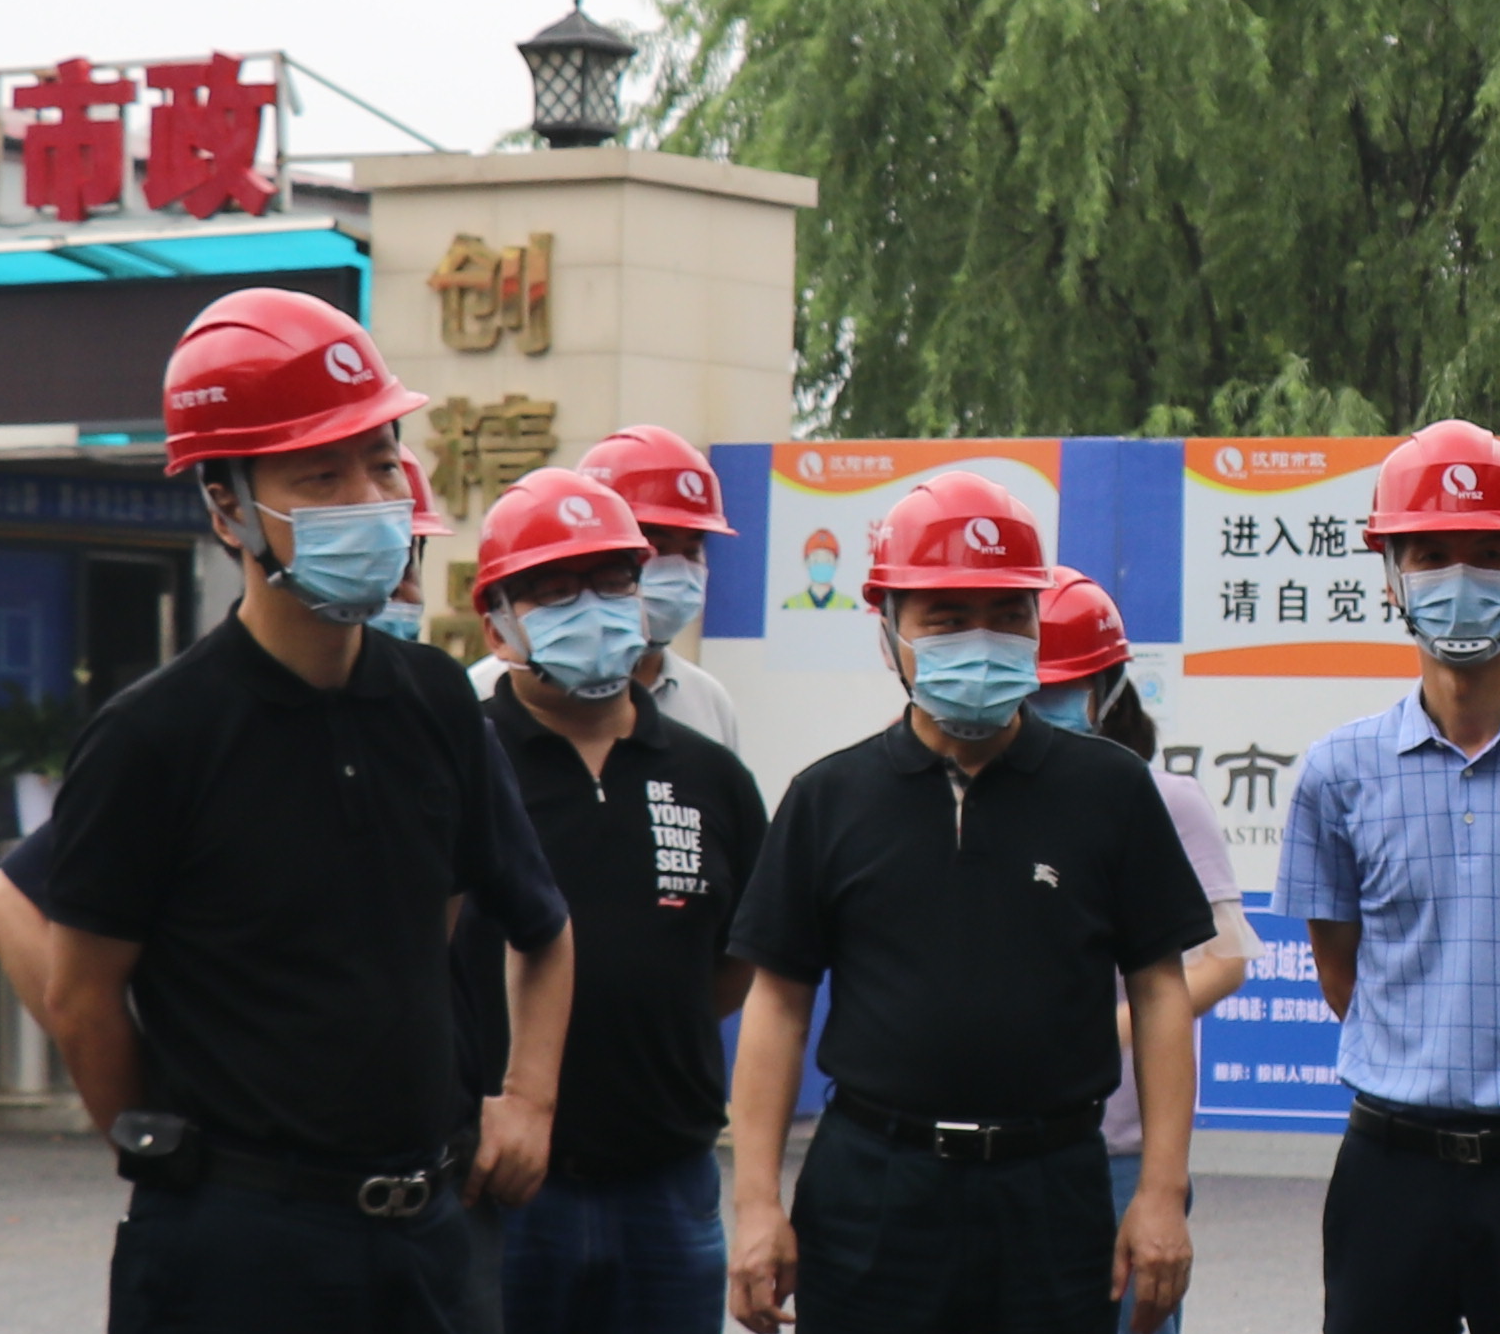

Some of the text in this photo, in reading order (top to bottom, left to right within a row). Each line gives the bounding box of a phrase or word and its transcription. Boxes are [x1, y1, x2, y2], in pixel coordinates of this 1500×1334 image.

[1458, 491, 1484, 500] HYSZ
[646, 780, 675, 803] BE
[648, 803, 702, 831] YOUR
[651, 826, 702, 853] TRUE
[656, 849, 702, 874] SELF
